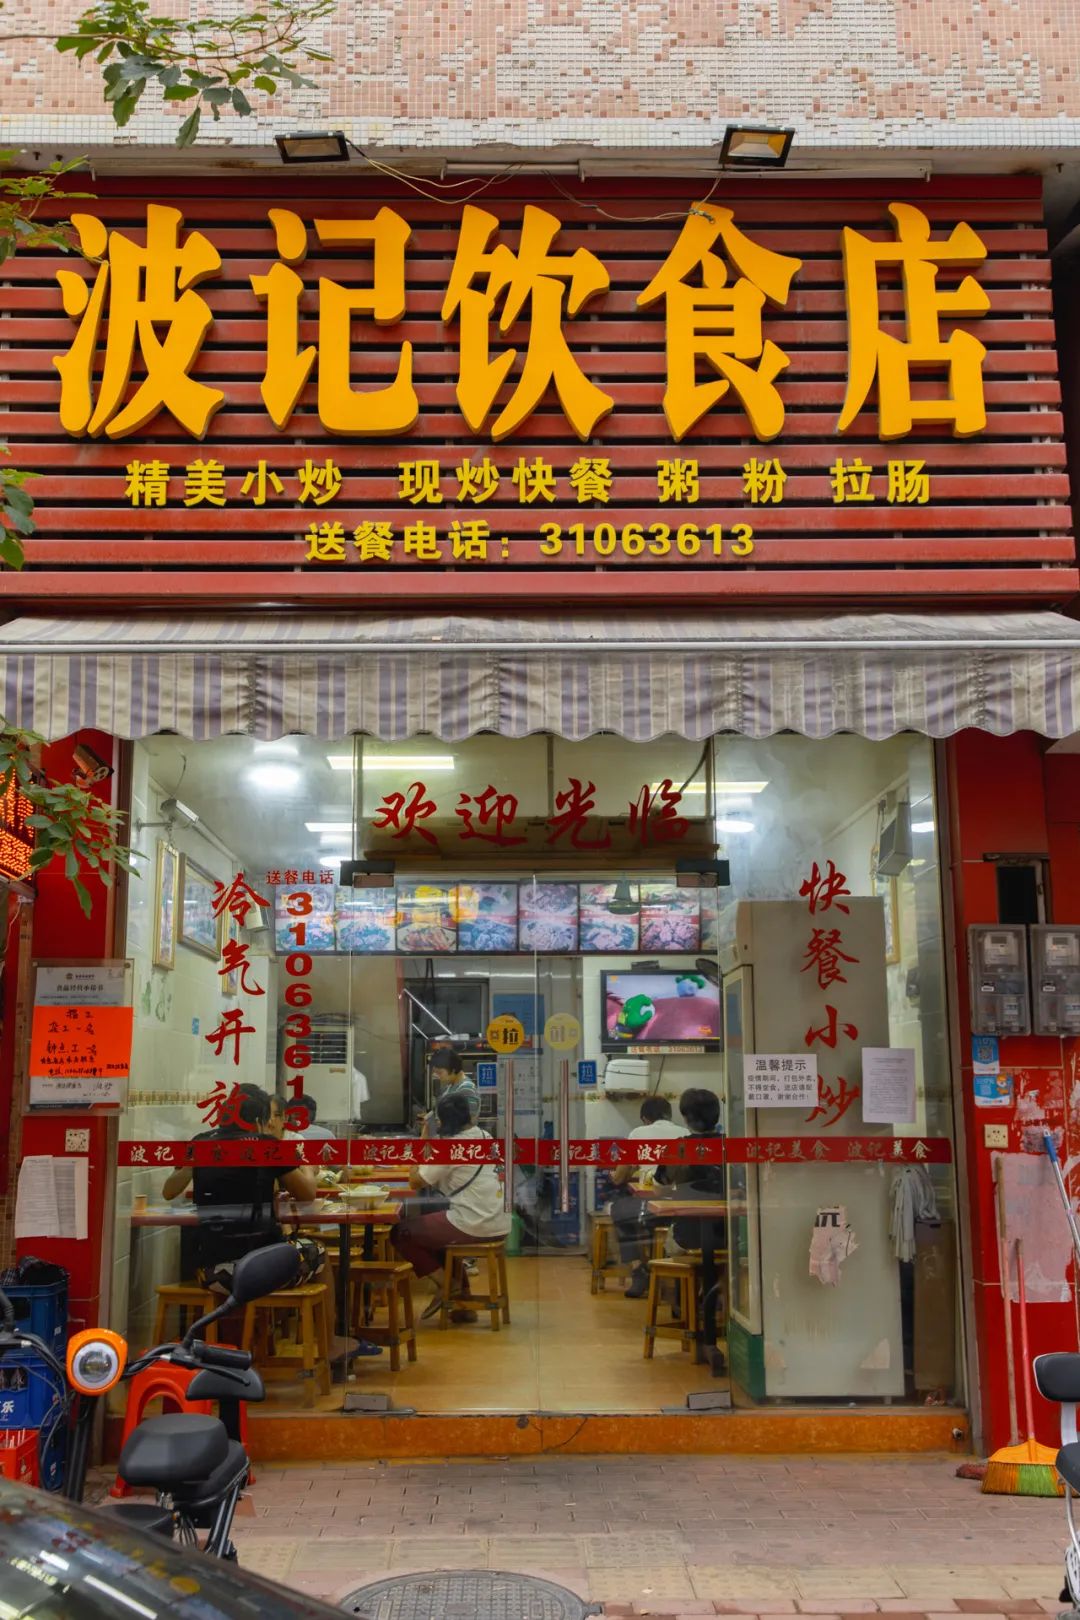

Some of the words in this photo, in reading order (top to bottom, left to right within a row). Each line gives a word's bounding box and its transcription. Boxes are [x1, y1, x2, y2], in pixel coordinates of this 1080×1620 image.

[53, 202, 990, 442] 波记饮食店
[125, 459, 343, 507] 精美小炒
[398, 457, 613, 504] 现炒快餐
[657, 458, 700, 504] 粥
[742, 458, 787, 504] 粉
[831, 458, 931, 504] 拉肠
[539, 522, 755, 557] 31063613
[372, 777, 690, 849] 欢迎光临
[266, 869, 334, 885] 送餐电话
[197, 872, 272, 1132] 冷气开放
[283, 891, 314, 1132] 31063613
[799, 859, 861, 1128] 快餐小炒
[755, 1058, 807, 1072] 温馨提示
[363, 1142, 440, 1163] 波记美食
